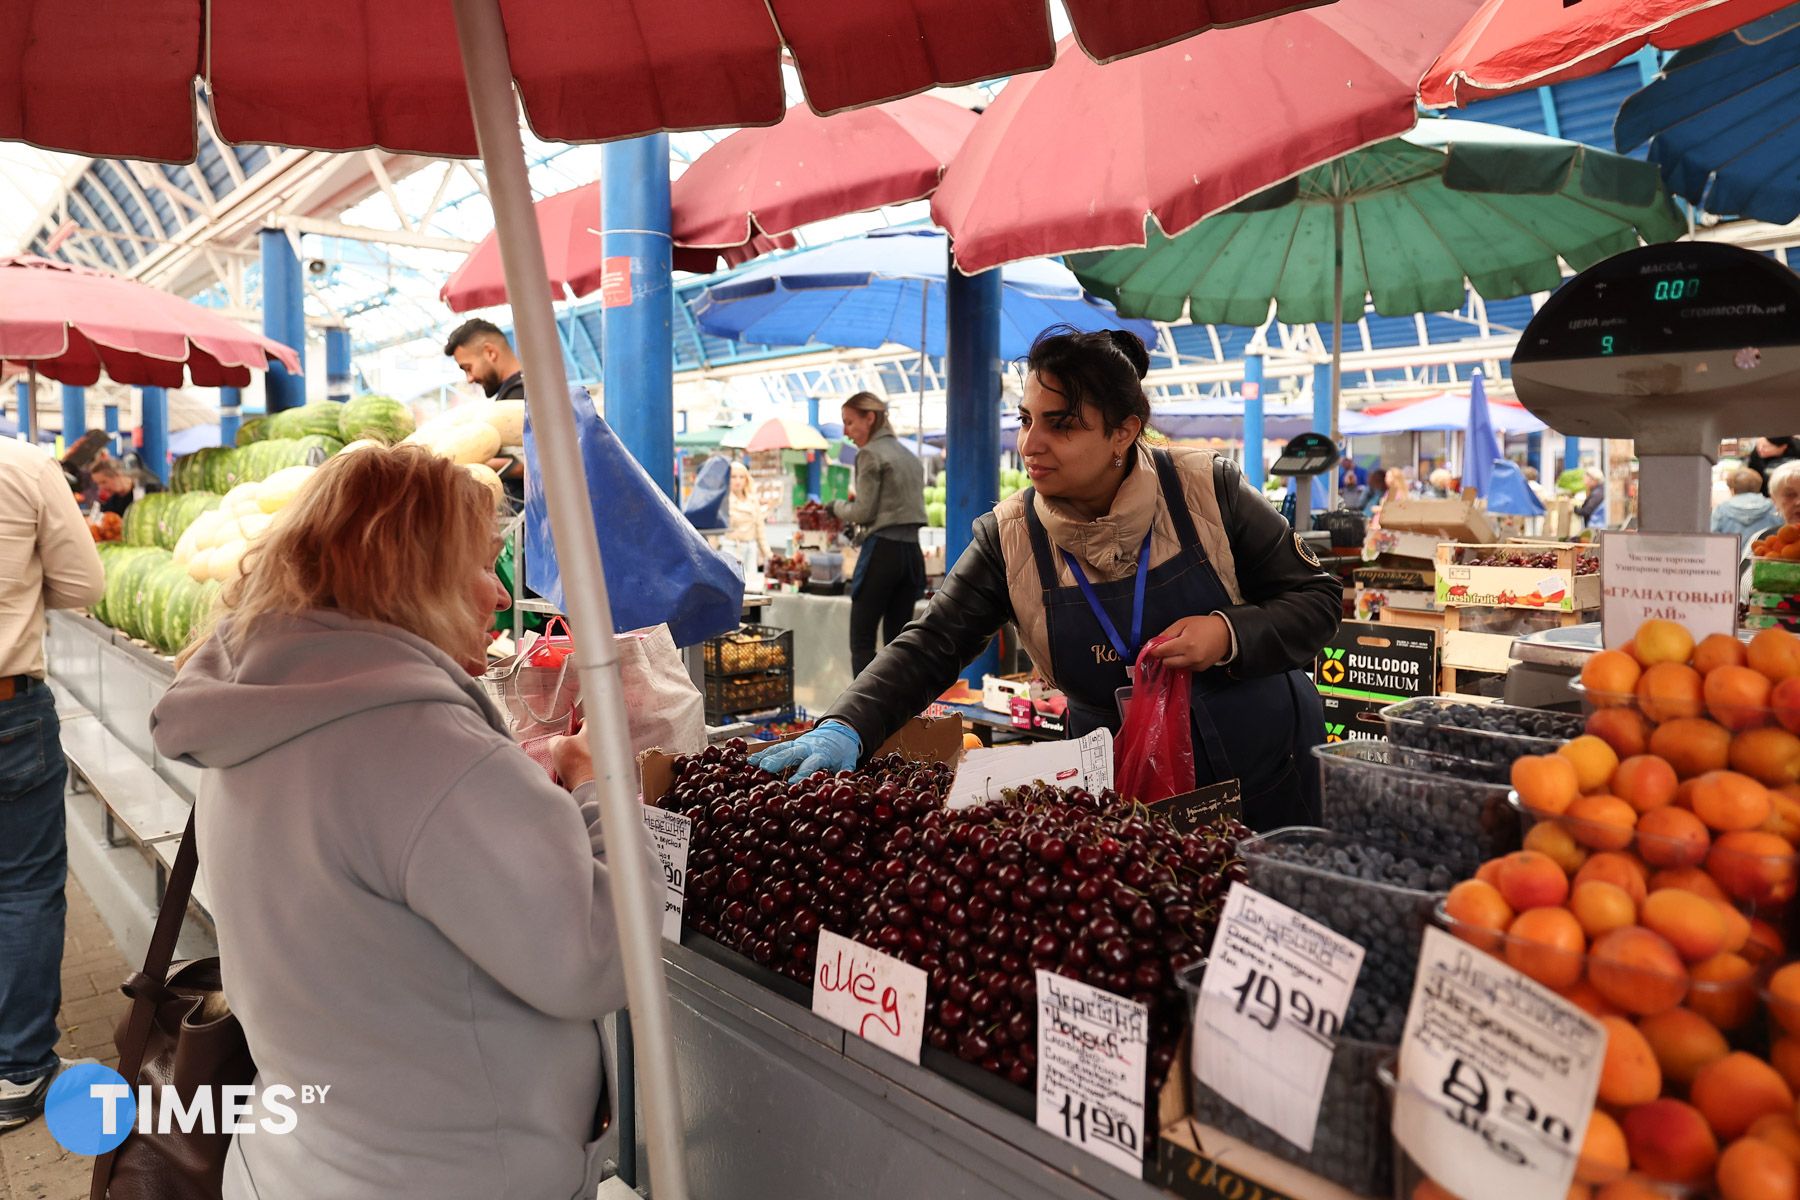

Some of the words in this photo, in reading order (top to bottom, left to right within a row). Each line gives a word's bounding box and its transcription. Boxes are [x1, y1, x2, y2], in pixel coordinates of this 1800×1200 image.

[1446, 592, 1470, 603] fresh
[1472, 593, 1499, 604] fruits
[1603, 586, 1734, 604] «ГРАНАТОВЫЙ
[1643, 607, 1687, 620] РАЙ»
[1349, 654, 1420, 676] RULLODOR
[1349, 670, 1420, 692] PREMIUM
[1233, 968, 1281, 1032] 19
